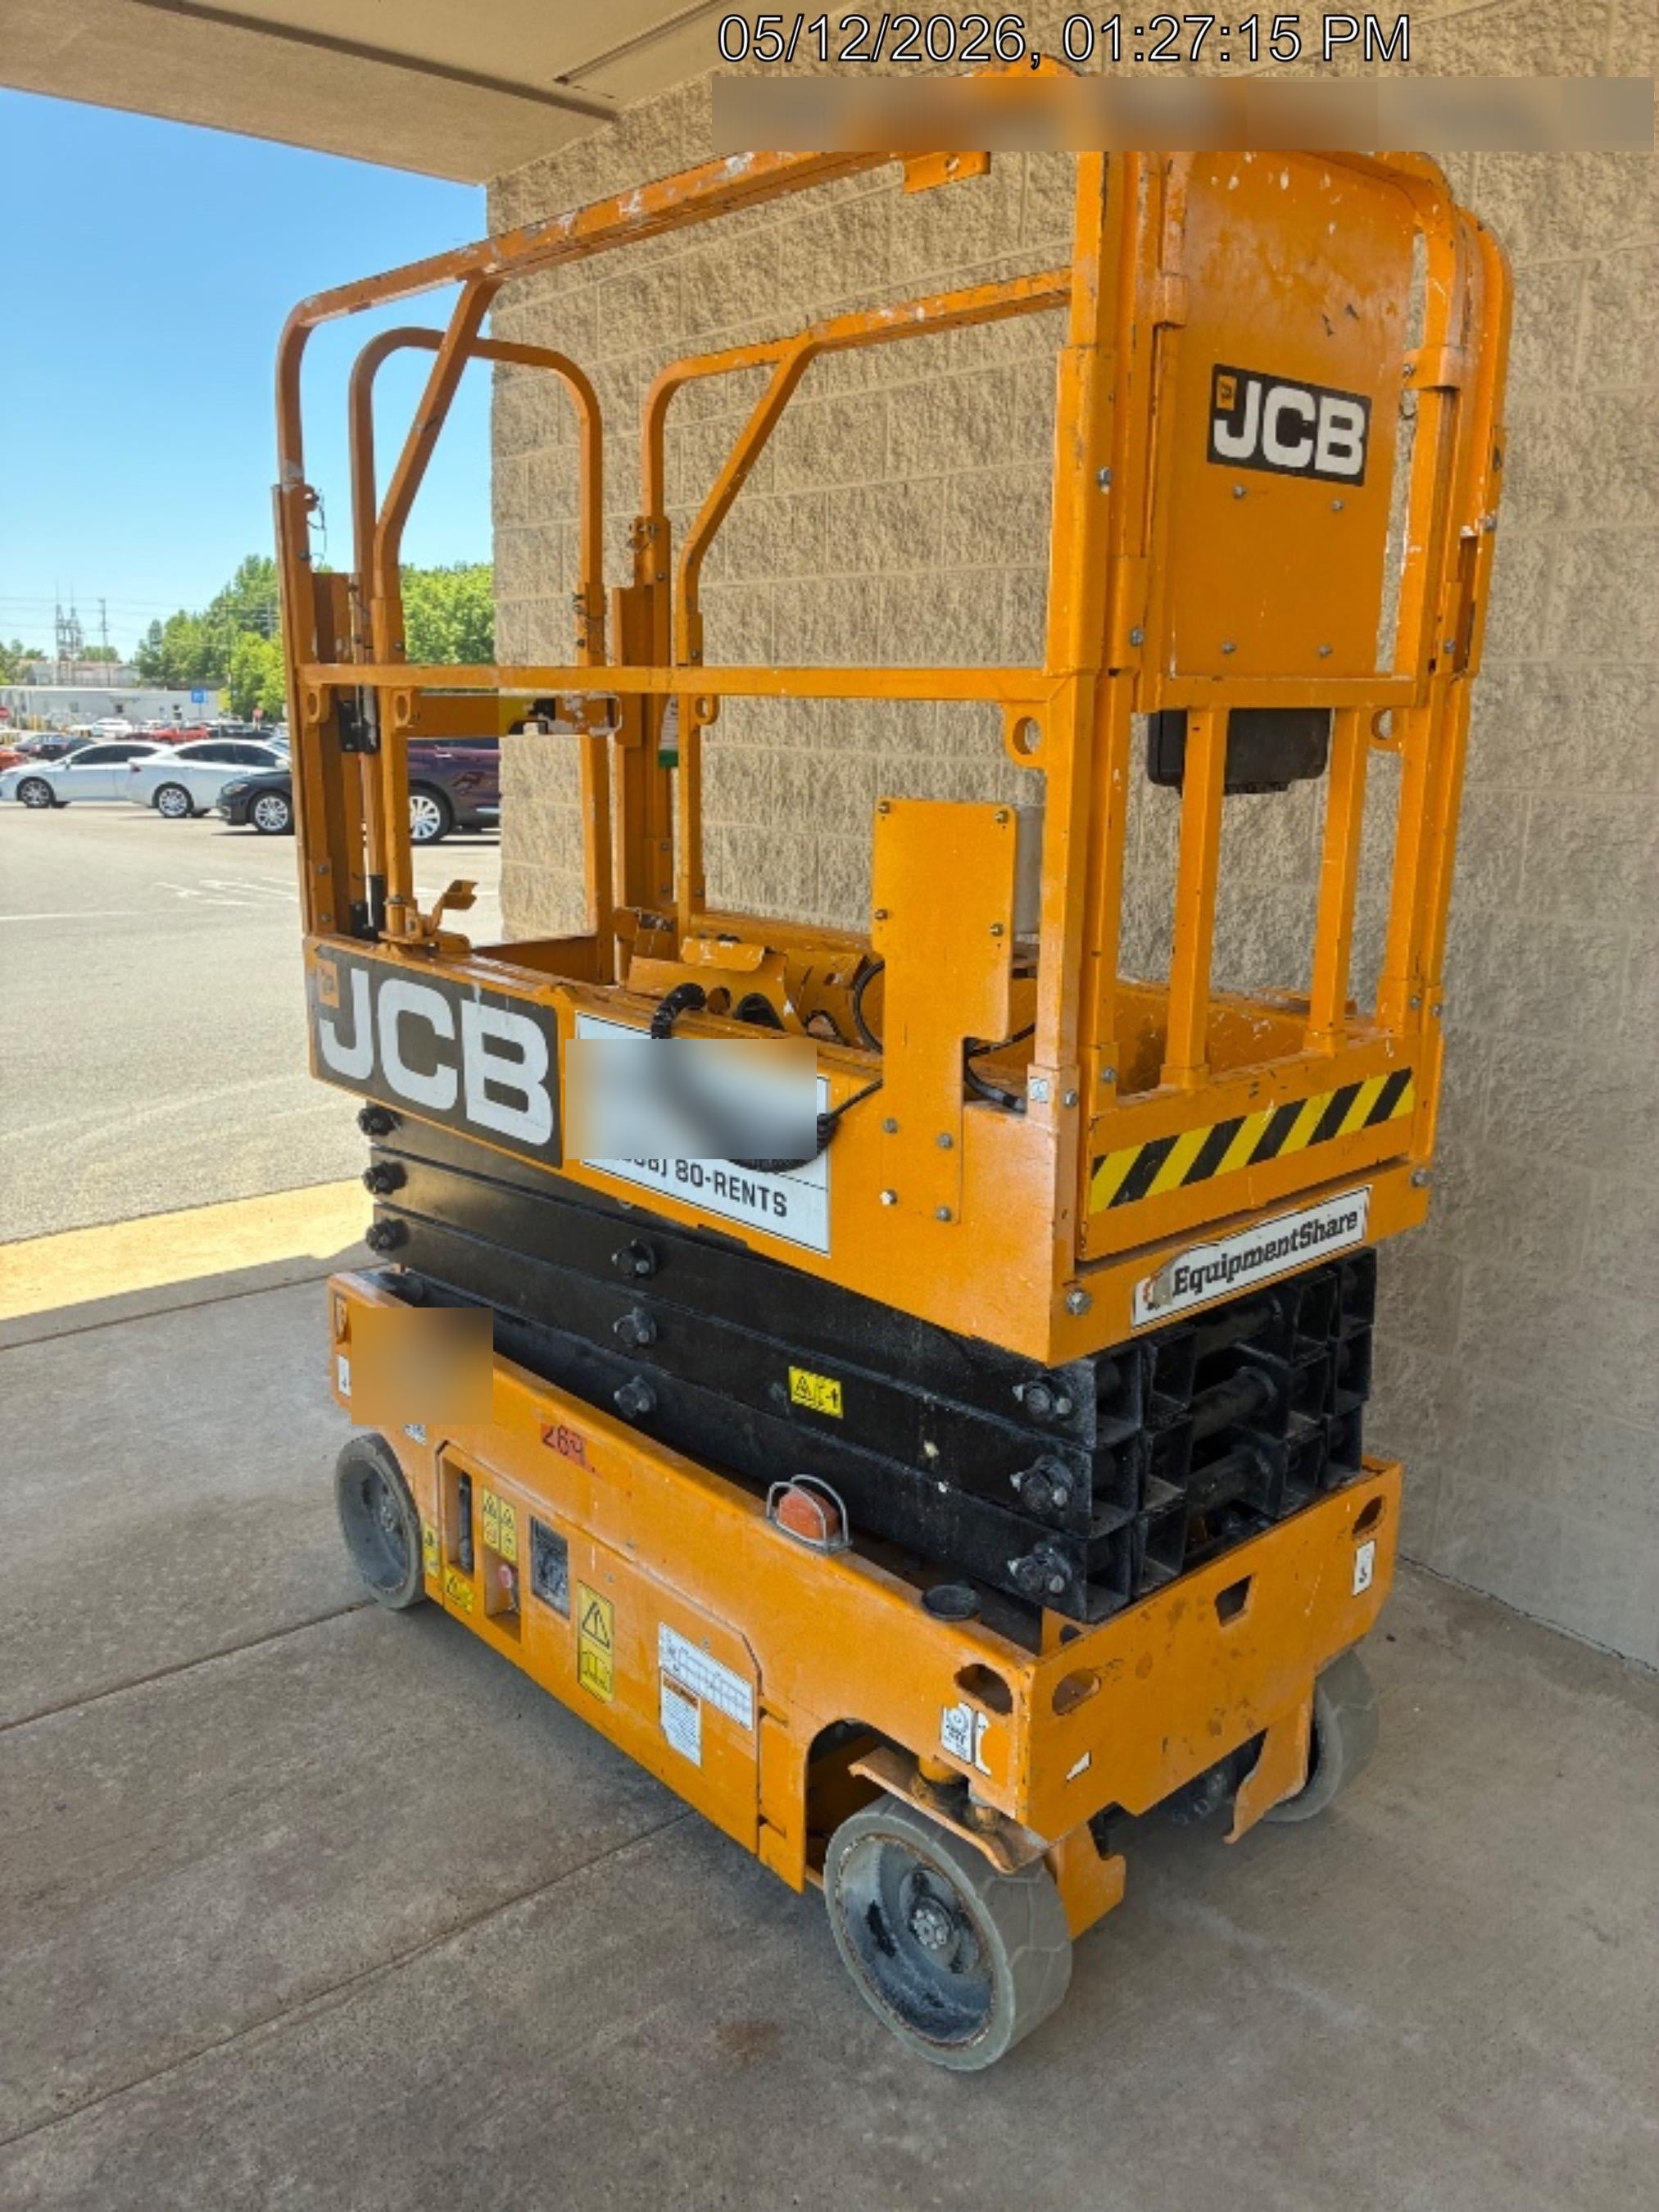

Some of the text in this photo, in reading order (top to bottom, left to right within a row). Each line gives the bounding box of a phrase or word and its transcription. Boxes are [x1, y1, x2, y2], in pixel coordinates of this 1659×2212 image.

[1213, 379, 1367, 476] JCB
[318, 967, 555, 1146] JCB
[674, 1158, 788, 1218] 80-RENTS
[1172, 1209, 1358, 1298] EquipmentShare
